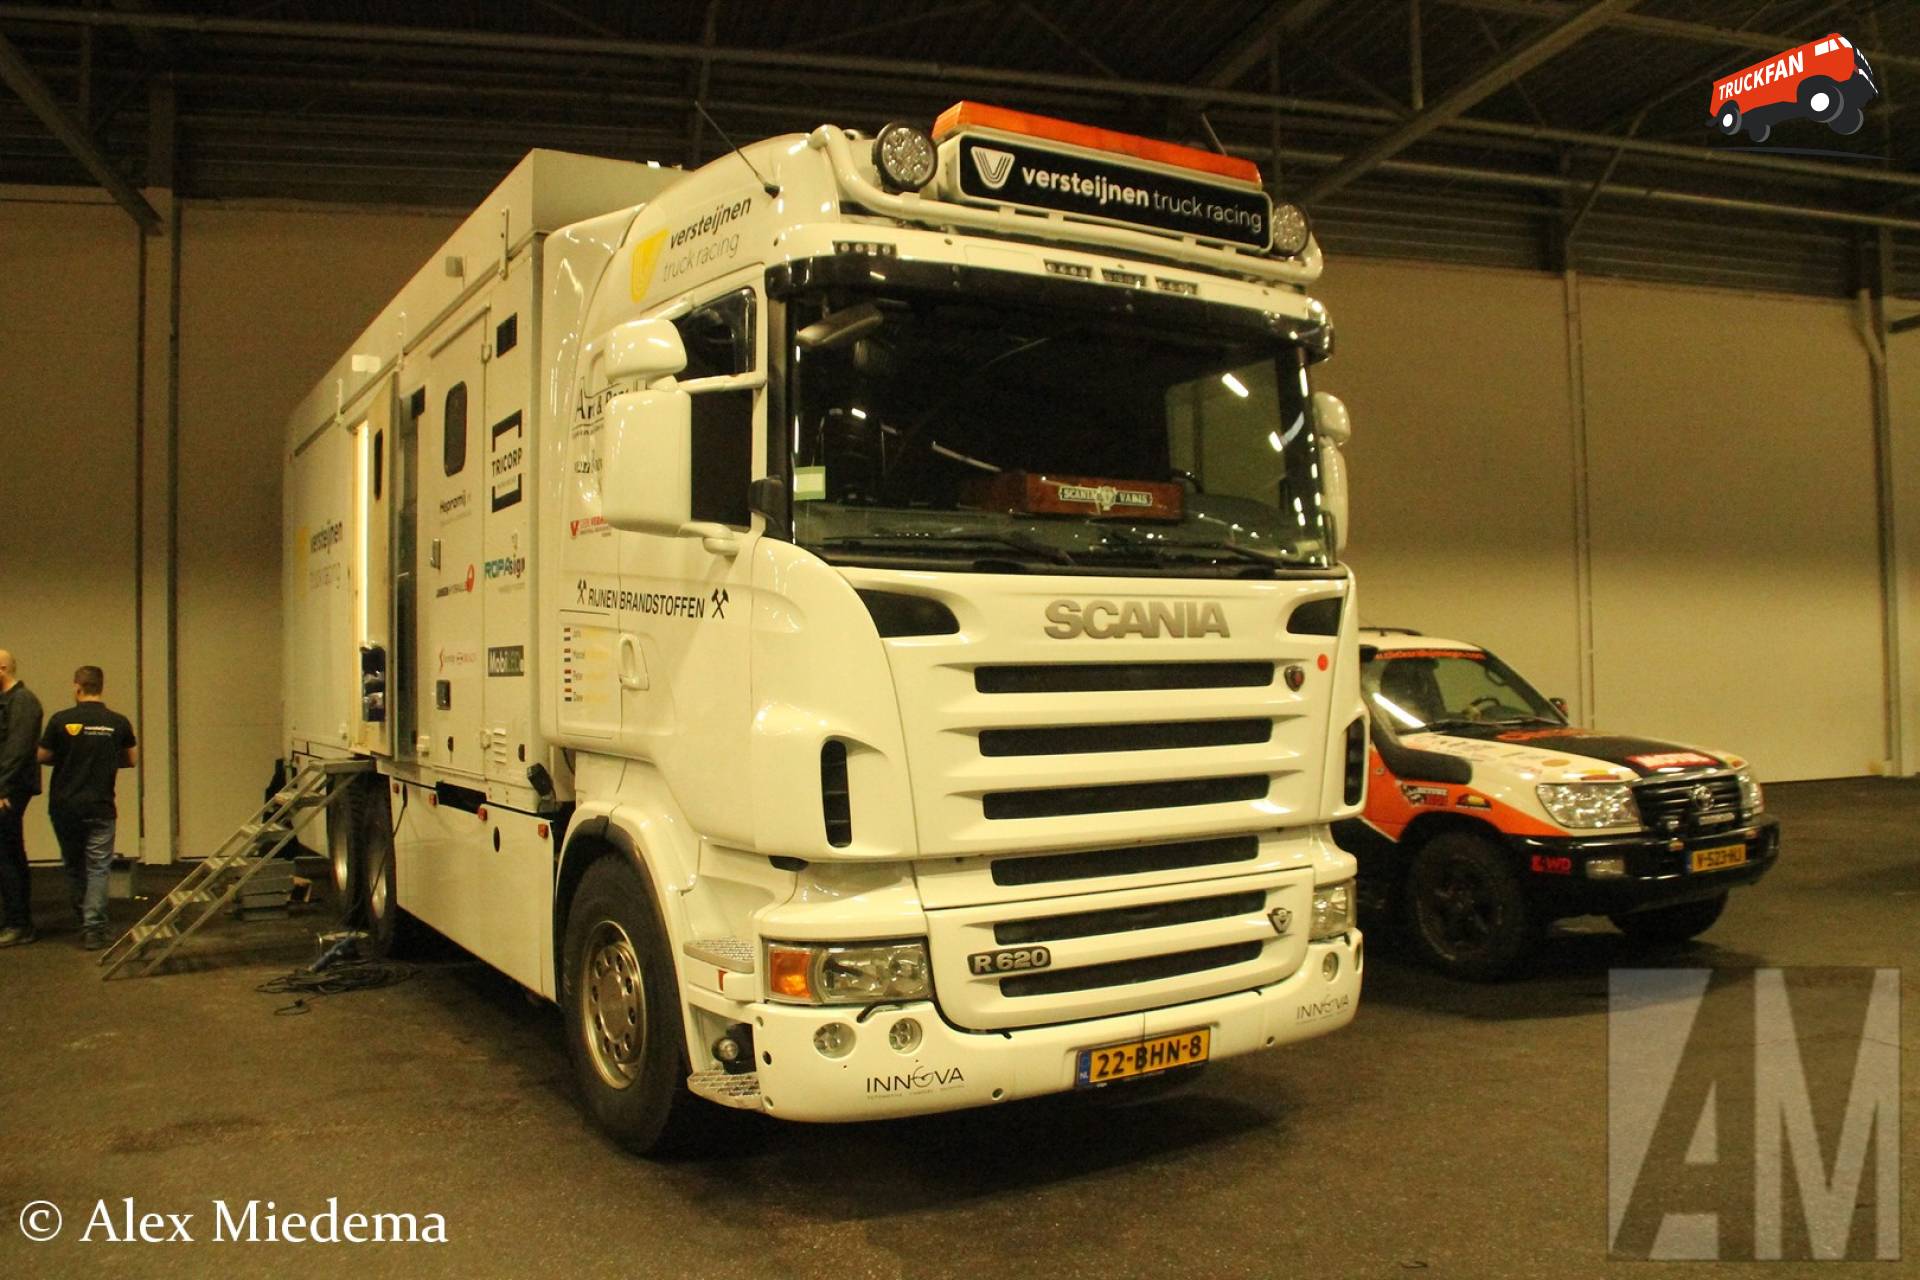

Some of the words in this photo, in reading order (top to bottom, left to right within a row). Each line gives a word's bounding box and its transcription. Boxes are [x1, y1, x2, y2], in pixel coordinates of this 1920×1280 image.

[1022, 165, 1149, 207] versteijnen
[1154, 191, 1202, 217] truck
[1206, 204, 1263, 233] racing
[670, 197, 752, 250] versteijnen
[663, 249, 695, 282] truck
[696, 233, 740, 265] racing
[492, 447, 522, 478] TRICORP
[588, 587, 618, 609] RIJNEN
[619, 590, 705, 618] BRANDSTOFFEN
[1044, 599, 1230, 640] SCANIA
[973, 955, 992, 974] R
[996, 949, 1049, 970] 620
[1096, 1035, 1203, 1078] 22-BHN-8
[866, 1065, 965, 1093] INNOVA
